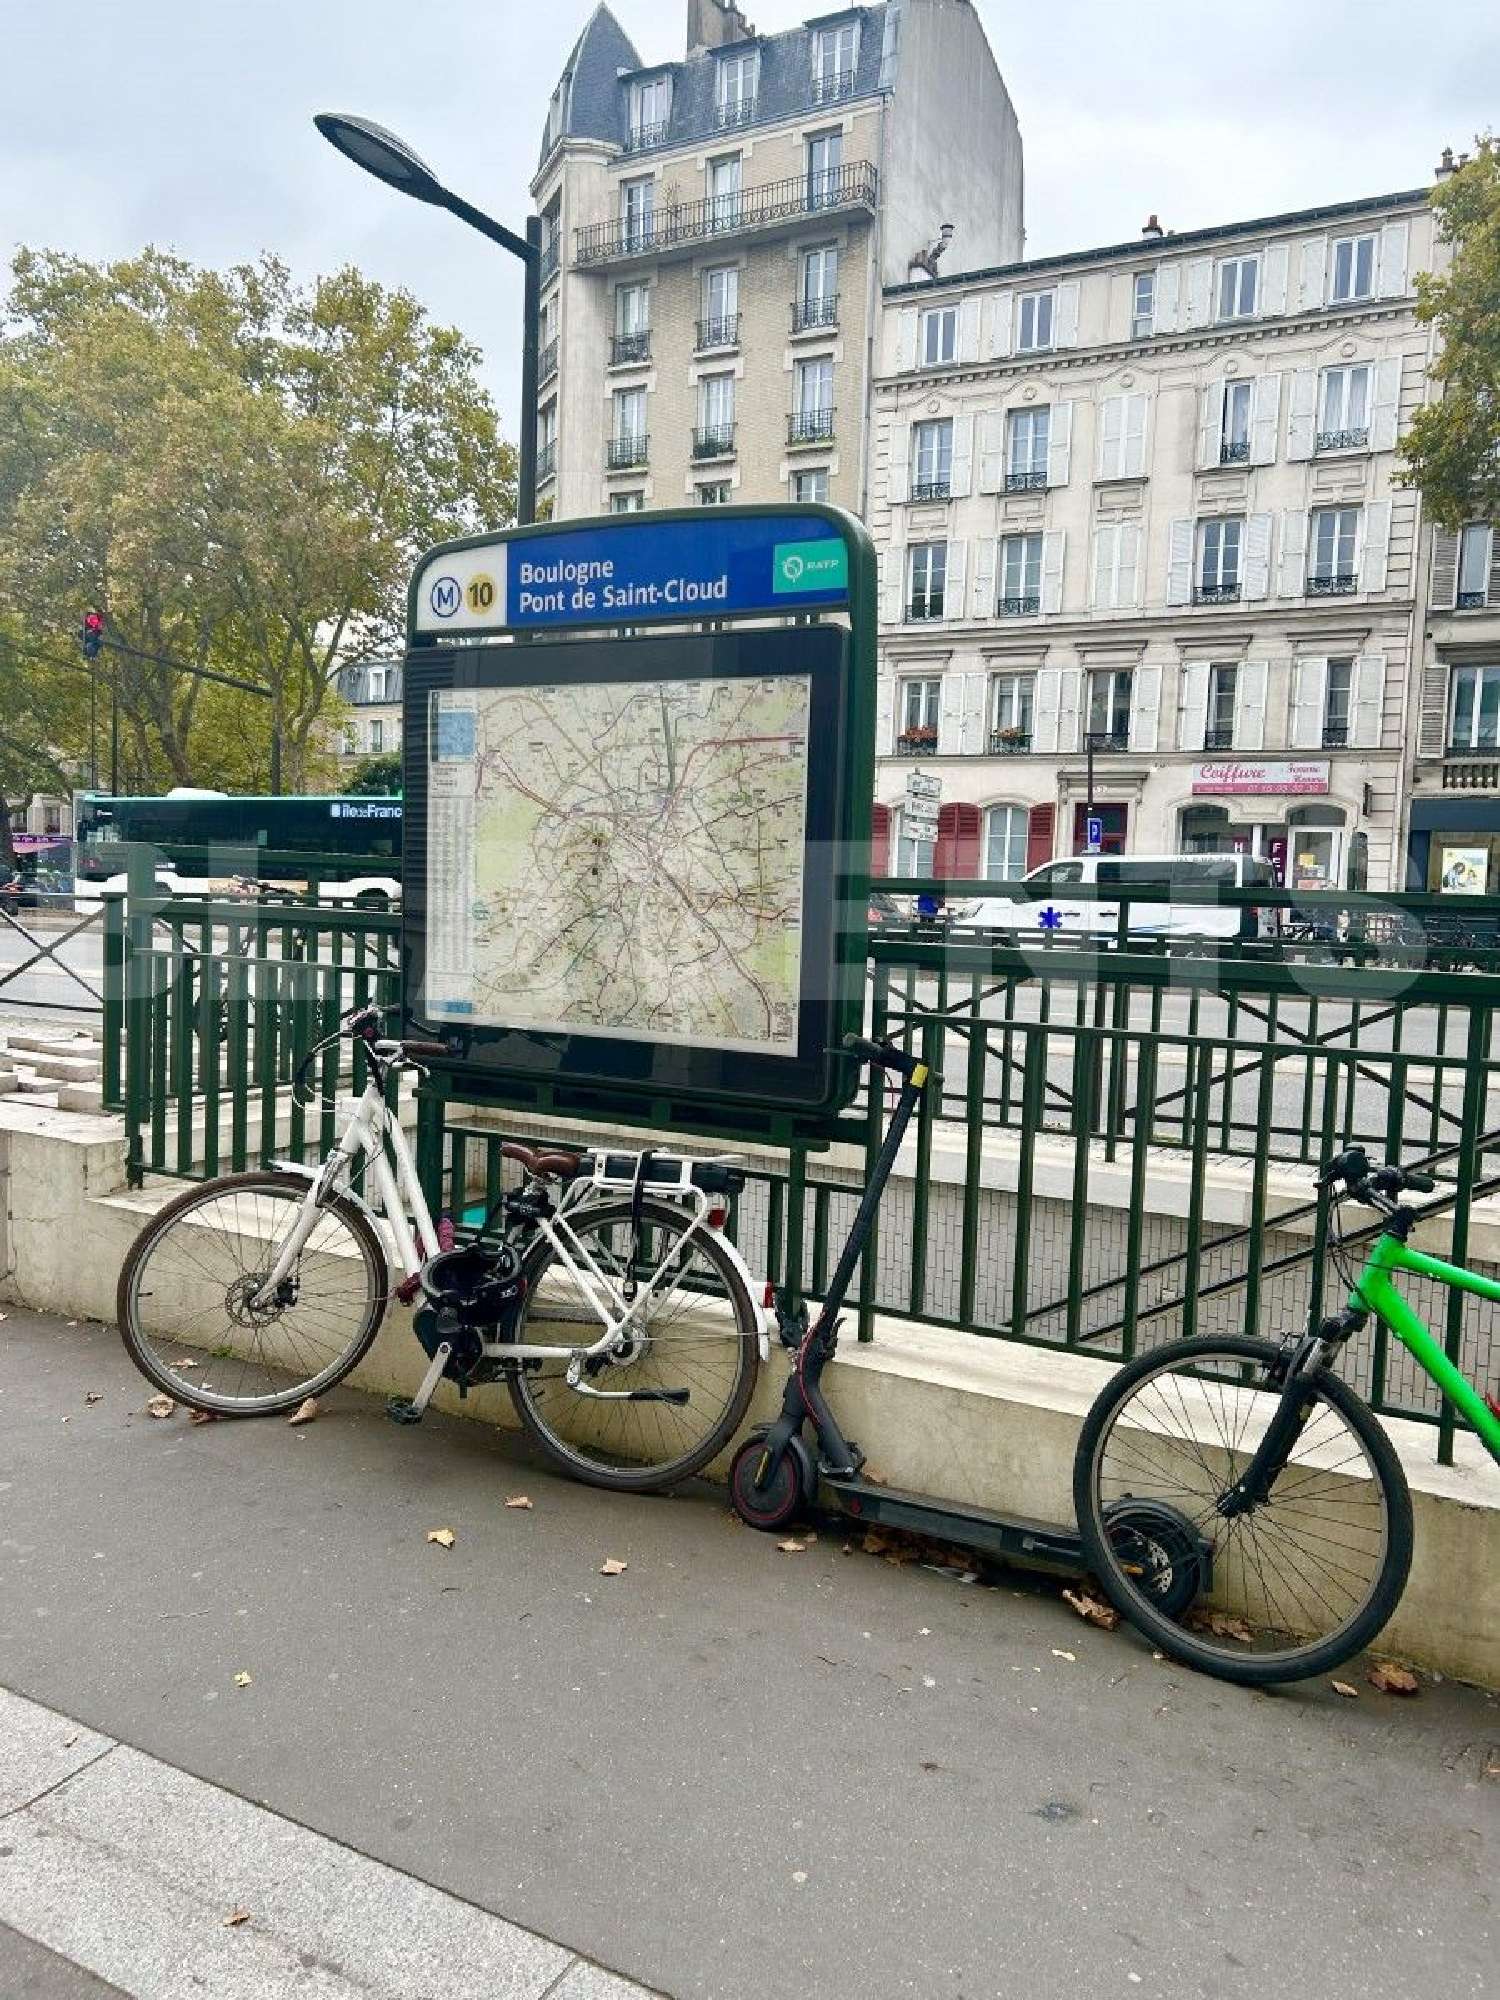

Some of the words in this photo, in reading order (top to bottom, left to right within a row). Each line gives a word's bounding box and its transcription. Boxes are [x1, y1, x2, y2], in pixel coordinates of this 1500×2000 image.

[519, 556, 614, 586] Boulogne
[806, 559, 839, 570] RATP
[437, 586, 454, 609] M
[469, 582, 493, 608] 10
[519, 589, 565, 613] Pont
[572, 586, 595, 609] de
[602, 575, 728, 608] Saint-Cloud
[1200, 761, 1266, 783] Coiffure
